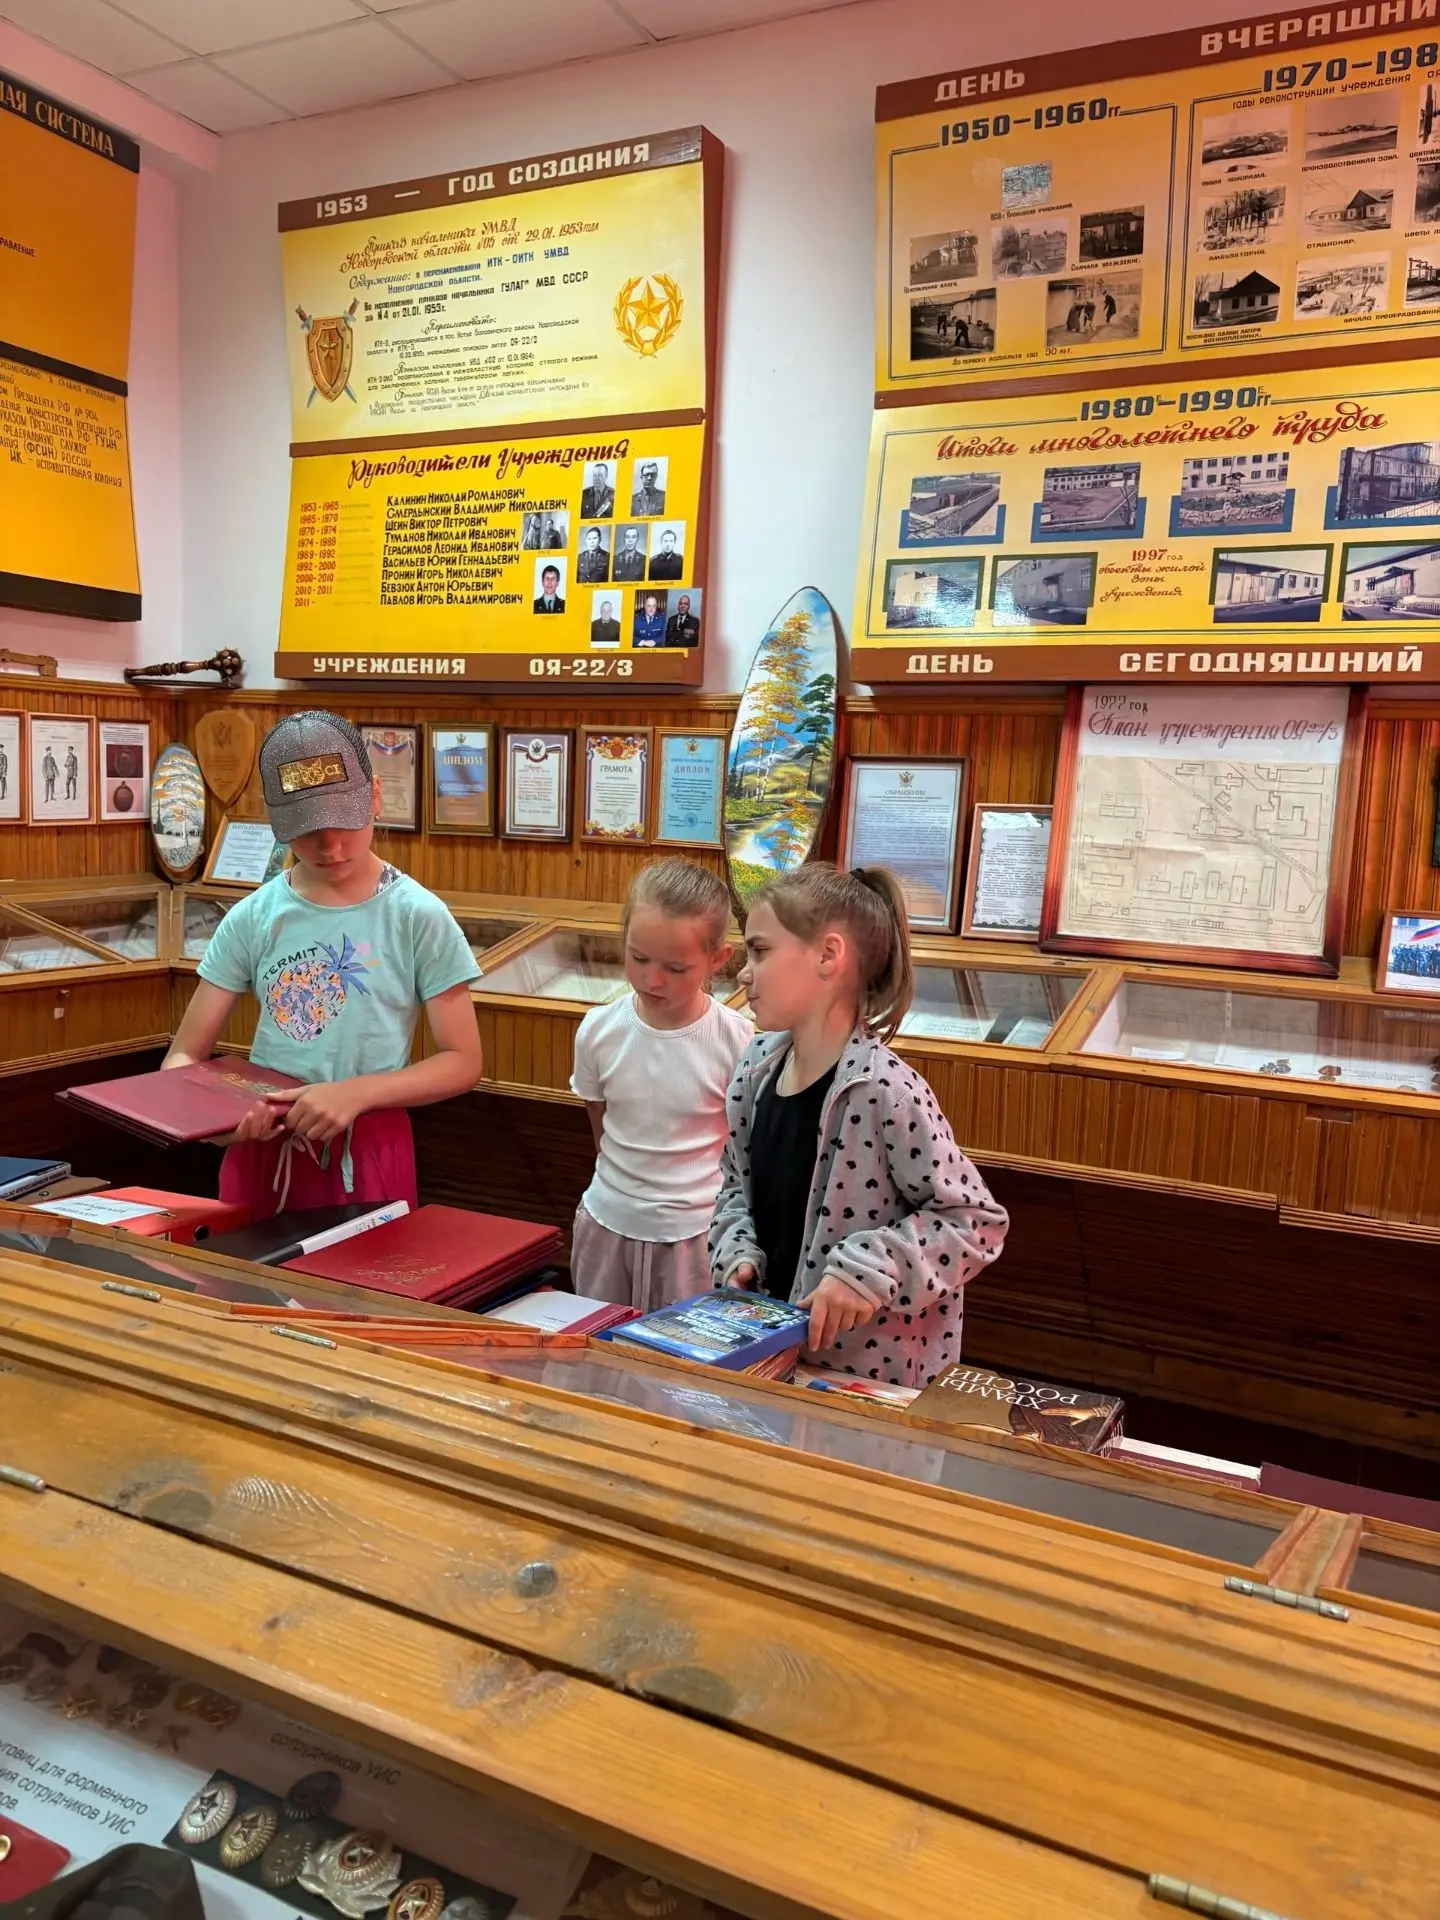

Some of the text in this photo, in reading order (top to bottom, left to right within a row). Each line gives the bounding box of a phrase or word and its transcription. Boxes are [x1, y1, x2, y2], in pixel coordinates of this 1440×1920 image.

[934, 69, 1025, 102] ДЕНЬ
[35, 101, 115, 158] СИСТЕМА
[317, 194, 368, 219] 1953
[448, 172, 495, 196] ГОД
[508, 143, 650, 186] СОЗДАНИЯ
[410, 223, 476, 246] начальника
[481, 217, 517, 235] УМВД
[423, 238, 471, 258] области
[543, 246, 569, 258] УМВД
[536, 275, 555, 287] МВД
[562, 270, 588, 284] СССР
[1029, 416, 1260, 454] многолетнего
[1273, 401, 1389, 446] труда
[348, 438, 631, 490] Руководители Учреждения
[386, 493, 426, 506] КАЛИНИН
[467, 487, 525, 501] РОМАНОВИЧ
[453, 501, 505, 515] ВЛАДИМИР
[508, 498, 567, 512] НИКОЛАЕВИЧ
[385, 515, 487, 531] ШЕИН ВИКТОР ПЕТРОВИЧ
[384, 530, 425, 543] ТУМАНОВ
[468, 526, 515, 539] ИВАНОВИЧ
[383, 539, 519, 555] ГЕРАСИМОВ ЛЕОНИД ИВАНОВИЧ
[382, 555, 425, 568] ВАСИЛЬЕВ
[458, 552, 519, 566] ГЕННАДЬЕВИЧ
[381, 566, 502, 580] ПРОНИН ИГОРЬ НИКОЛАЕВИЧ
[380, 579, 493, 593] БЕВЗЮК АНТОН ЮРЬЕВИЧ
[380, 591, 523, 605] ПАВЛОВ ИГОРЬ ВЛАДИМИРОВИЧ
[313, 657, 634, 676] УЧРЕЖДЕНИЯ ОЯ-22/3
[906, 645, 1424, 674] ДЕНЬ СЕГОДНЯШНИЙ
[1088, 712, 1148, 737] План
[1160, 719, 1279, 749] учреждения
[600, 764, 633, 773] ГРАМОТА
[674, 764, 710, 774] ДИПЛОМ
[263, 947, 317, 981] TERMIT
[937, 1377, 1047, 1410] ХРАМЫ
[947, 1367, 1080, 1405] РОССИИ
[271, 1732, 401, 1785] сотрудников УИС
[35, 1761, 66, 1779] для
[64, 1770, 148, 1815] форменного
[17, 1777, 100, 1820] сотрудников
[99, 1810, 136, 1835] УИС
